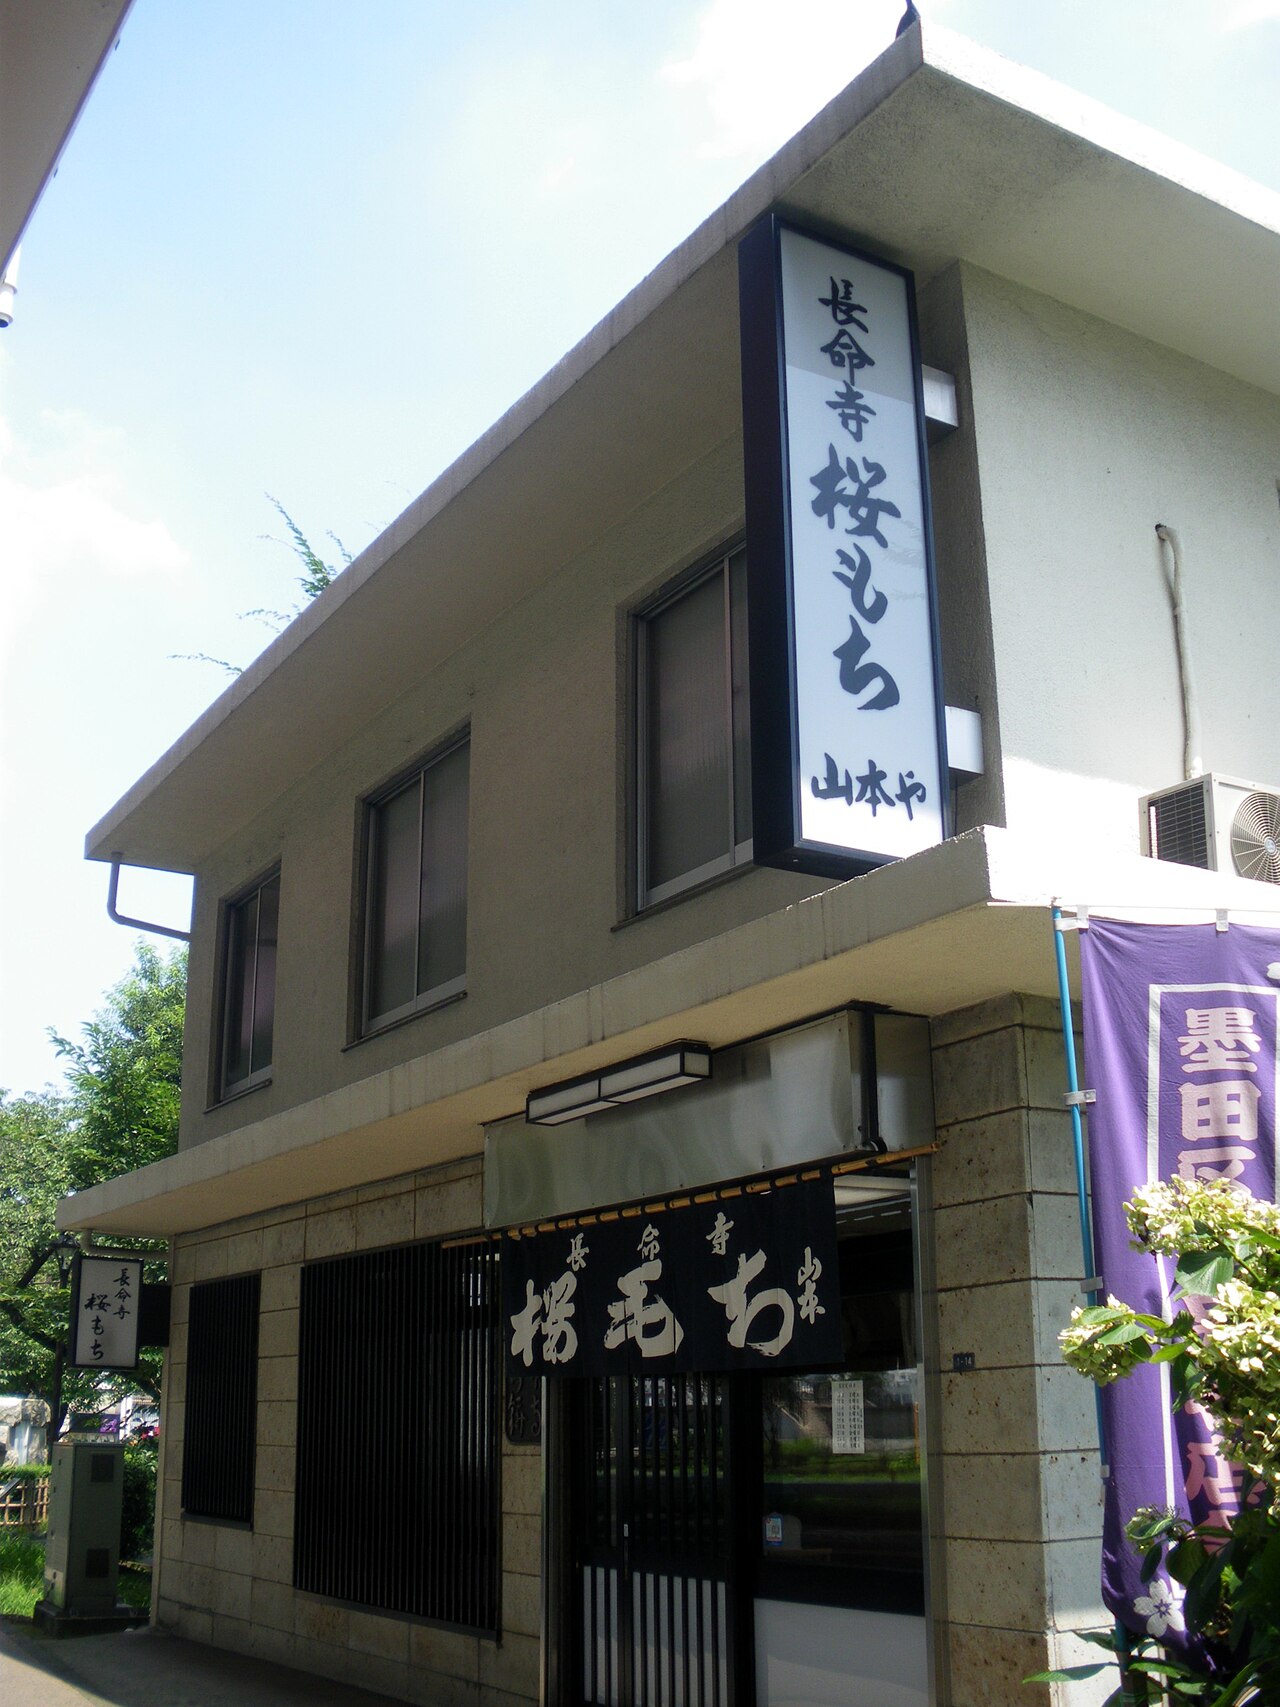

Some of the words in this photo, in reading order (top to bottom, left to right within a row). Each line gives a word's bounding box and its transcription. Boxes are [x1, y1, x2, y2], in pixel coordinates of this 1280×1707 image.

[818, 276, 877, 442] 長命寺
[810, 443, 902, 711] 桜もち
[810, 753, 928, 821] 山本や
[84, 1293, 111, 1361] 桜もち
[113, 1268, 131, 1320] 長命寺
